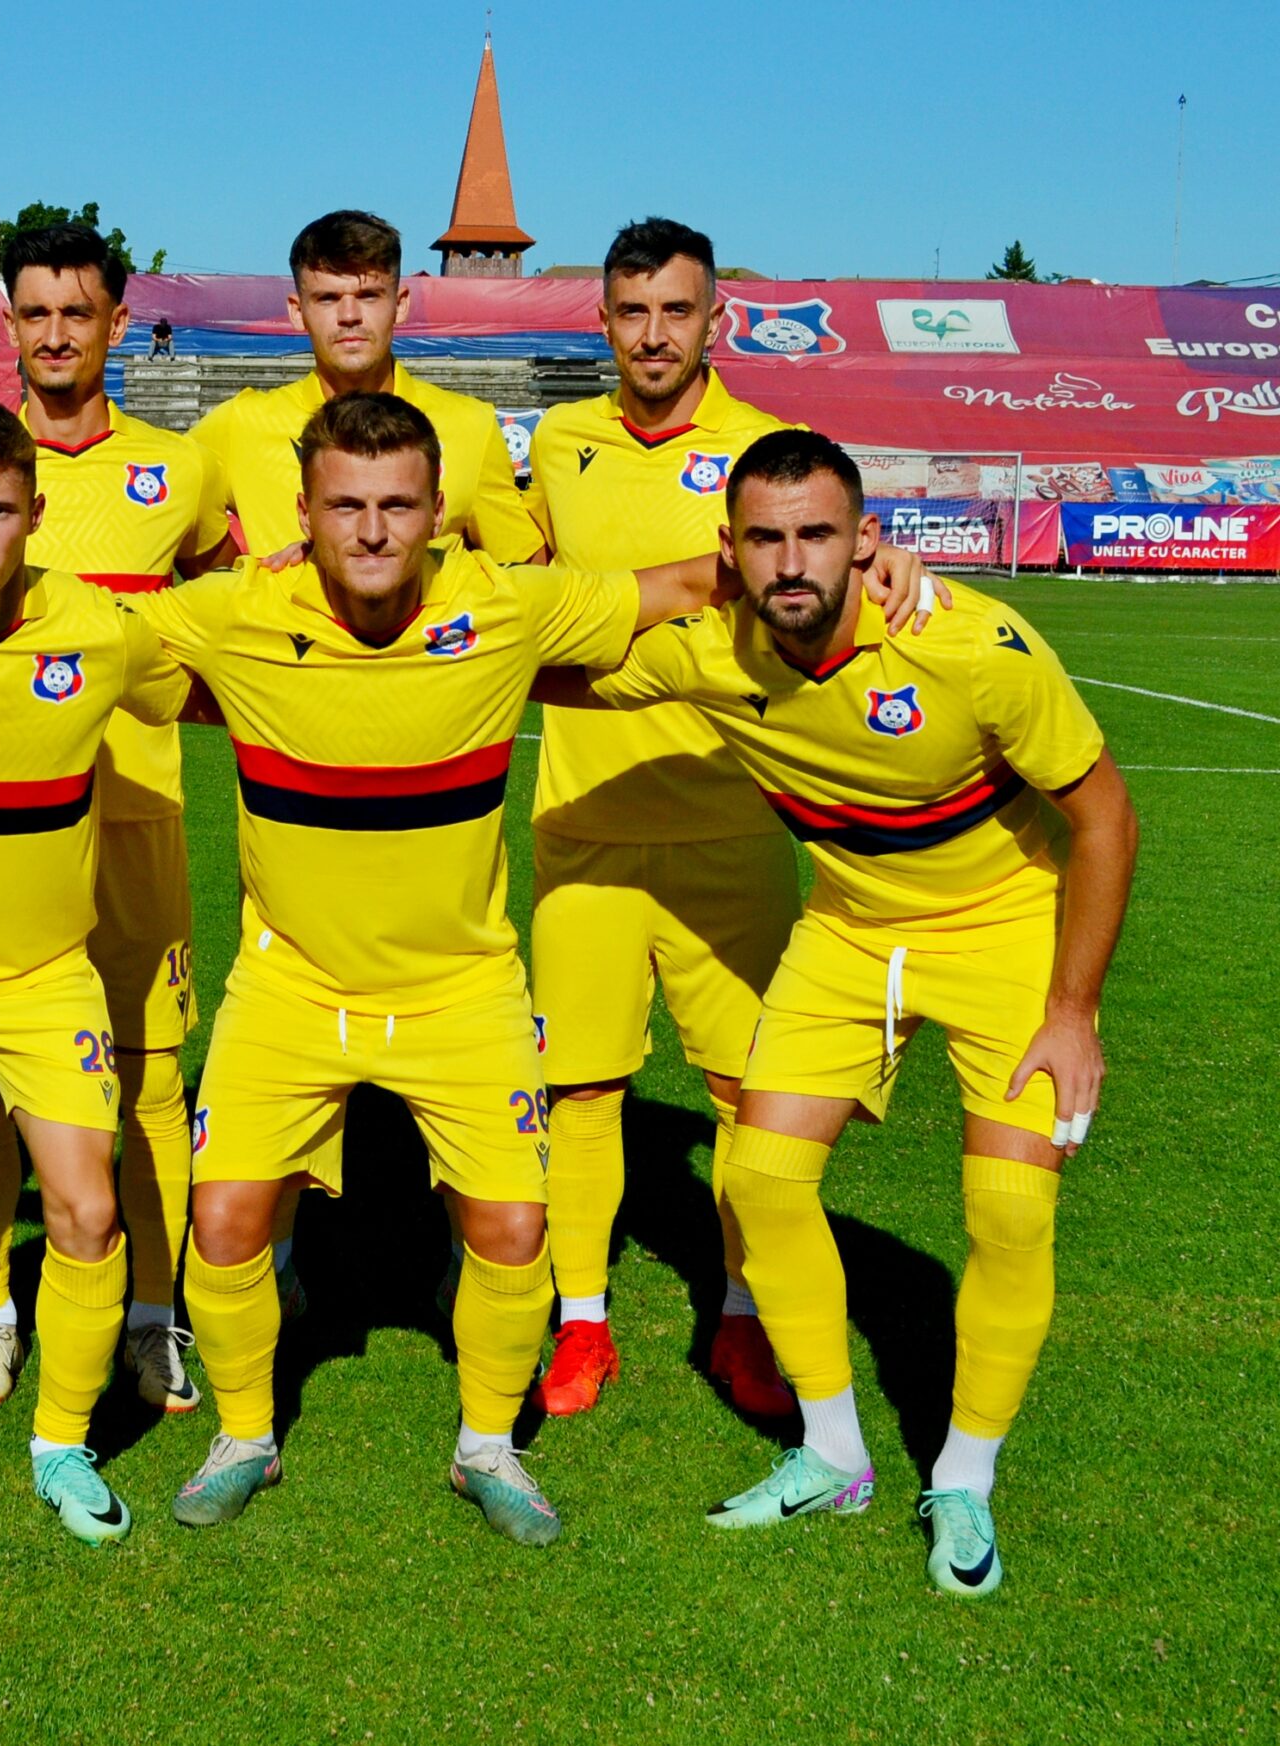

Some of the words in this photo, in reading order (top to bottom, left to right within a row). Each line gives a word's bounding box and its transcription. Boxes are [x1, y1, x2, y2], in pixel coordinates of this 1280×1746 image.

[1161, 469, 1203, 485] Viva
[892, 515, 989, 536] MOKA
[920, 536, 990, 554] GSM
[1092, 545, 1145, 558] UNELTE
[1148, 545, 1169, 558] CU
[1172, 546, 1247, 560] CARACTER
[73, 1029, 117, 1075] 28
